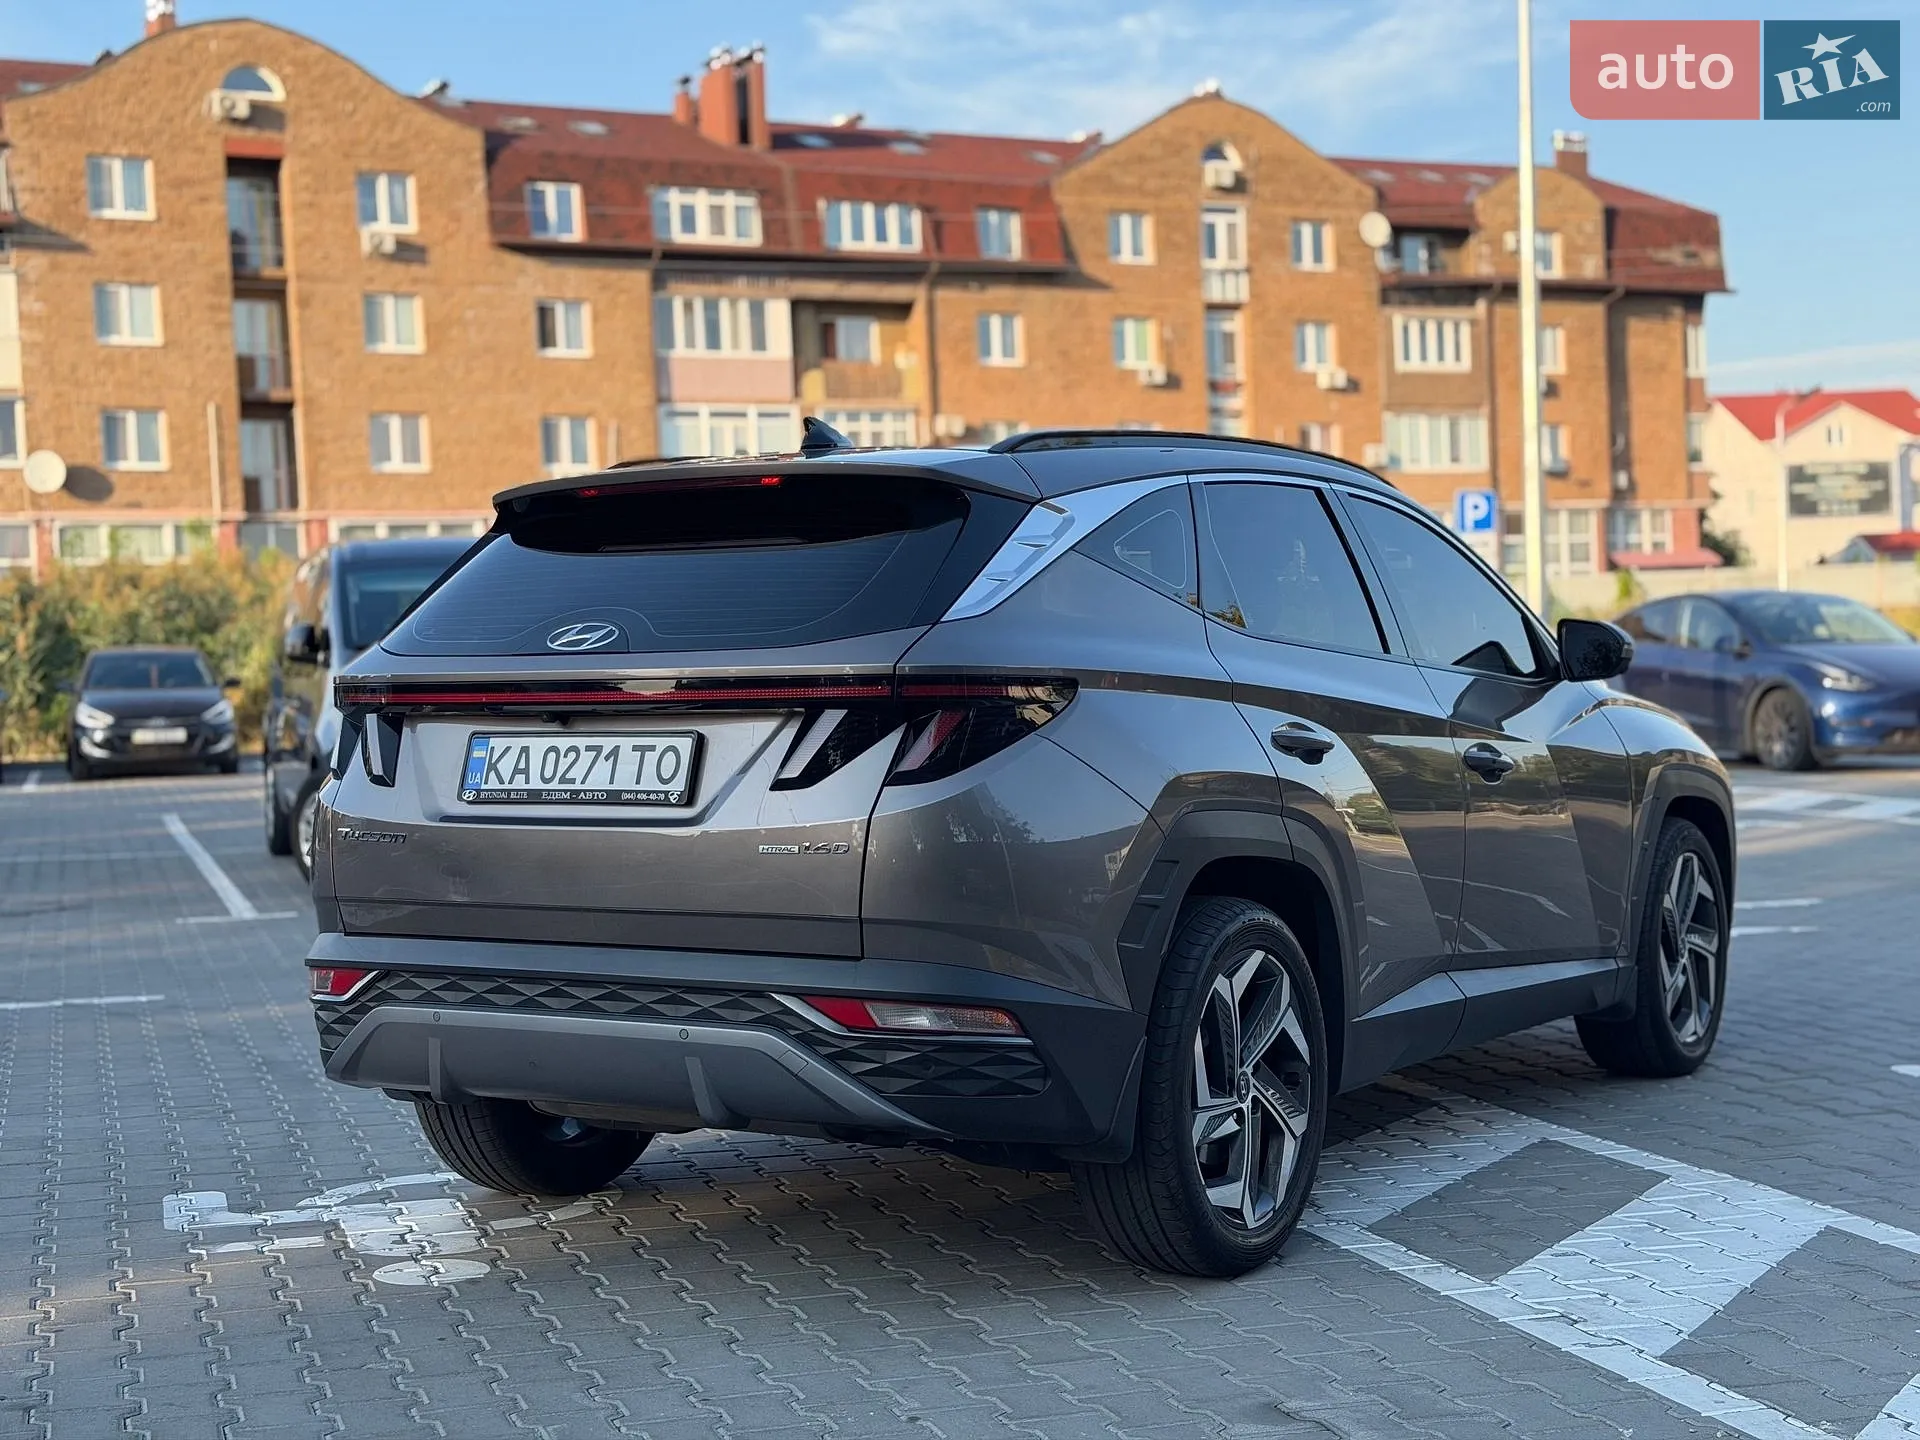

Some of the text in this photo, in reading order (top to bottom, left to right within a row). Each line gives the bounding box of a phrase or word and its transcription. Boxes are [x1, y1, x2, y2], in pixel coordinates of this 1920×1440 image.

[1464, 493, 1489, 531] P
[483, 744, 682, 786] KA 0271 TO
[468, 772, 481, 784] UA
[480, 791, 528, 799] HYUNDAI ELITE
[542, 791, 571, 800] ЕДЕМ
[578, 791, 607, 799] АВТО
[621, 792, 636, 800] (044)
